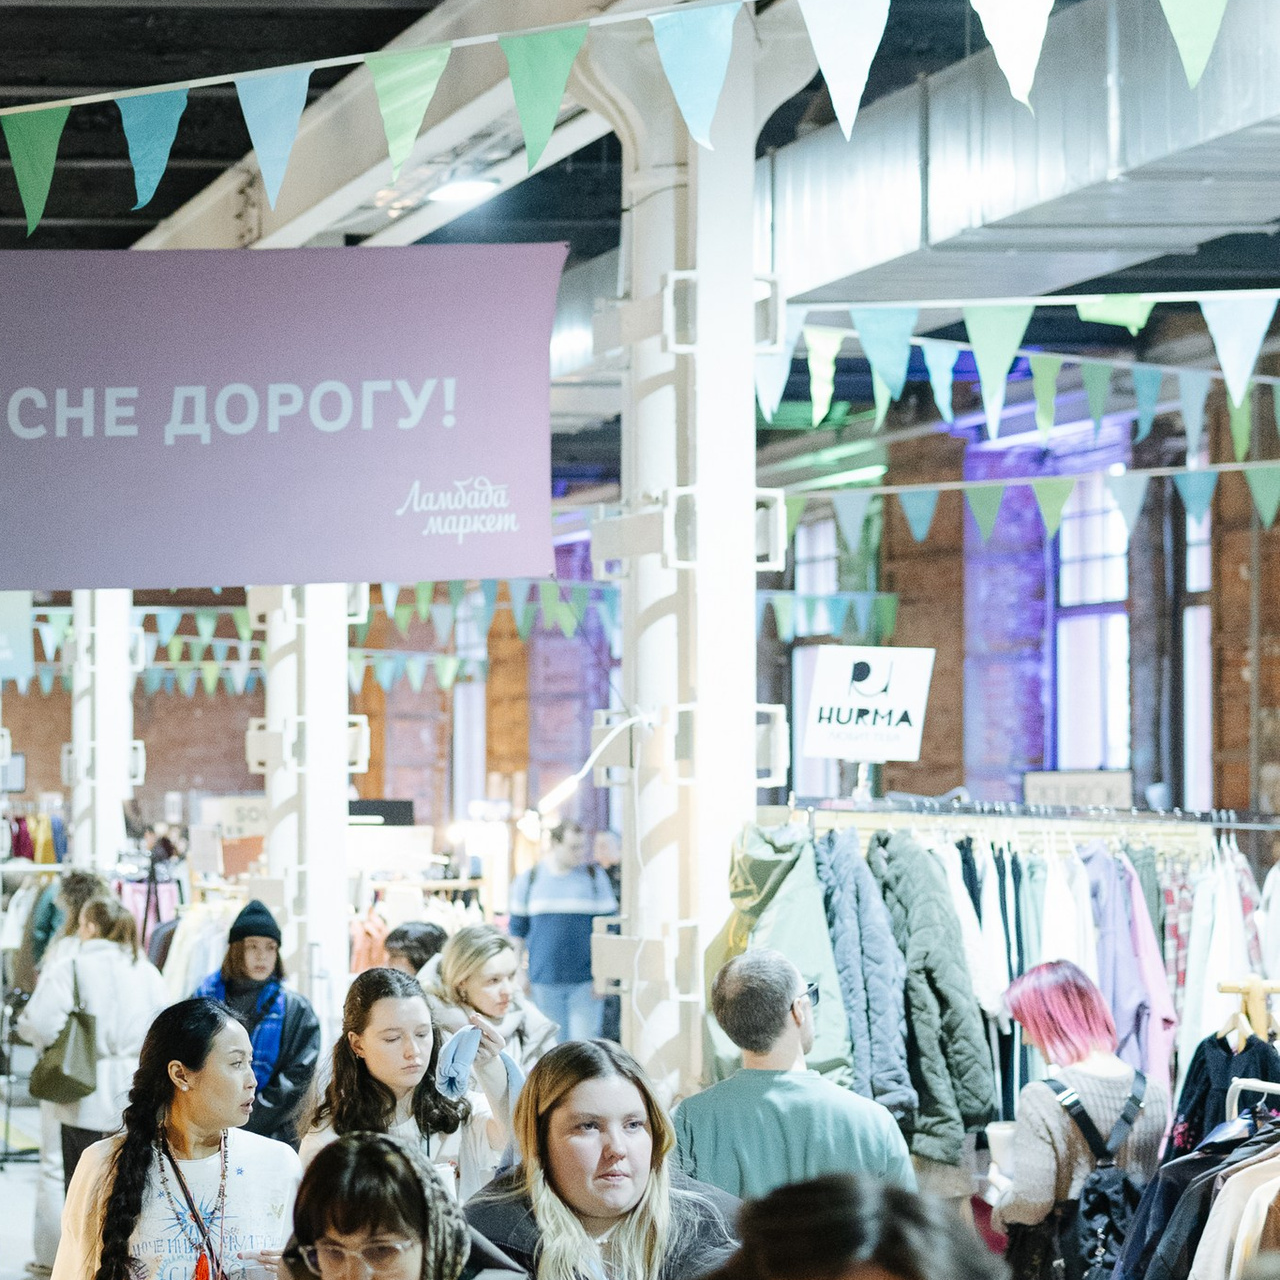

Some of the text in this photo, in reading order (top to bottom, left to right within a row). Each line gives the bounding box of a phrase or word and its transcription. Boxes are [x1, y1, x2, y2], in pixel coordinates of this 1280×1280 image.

[163, 377, 457, 447] ДОРОГУ!
[395, 476, 510, 516] Ламбада
[422, 512, 520, 545] маркет
[818, 706, 913, 727] HURMA
